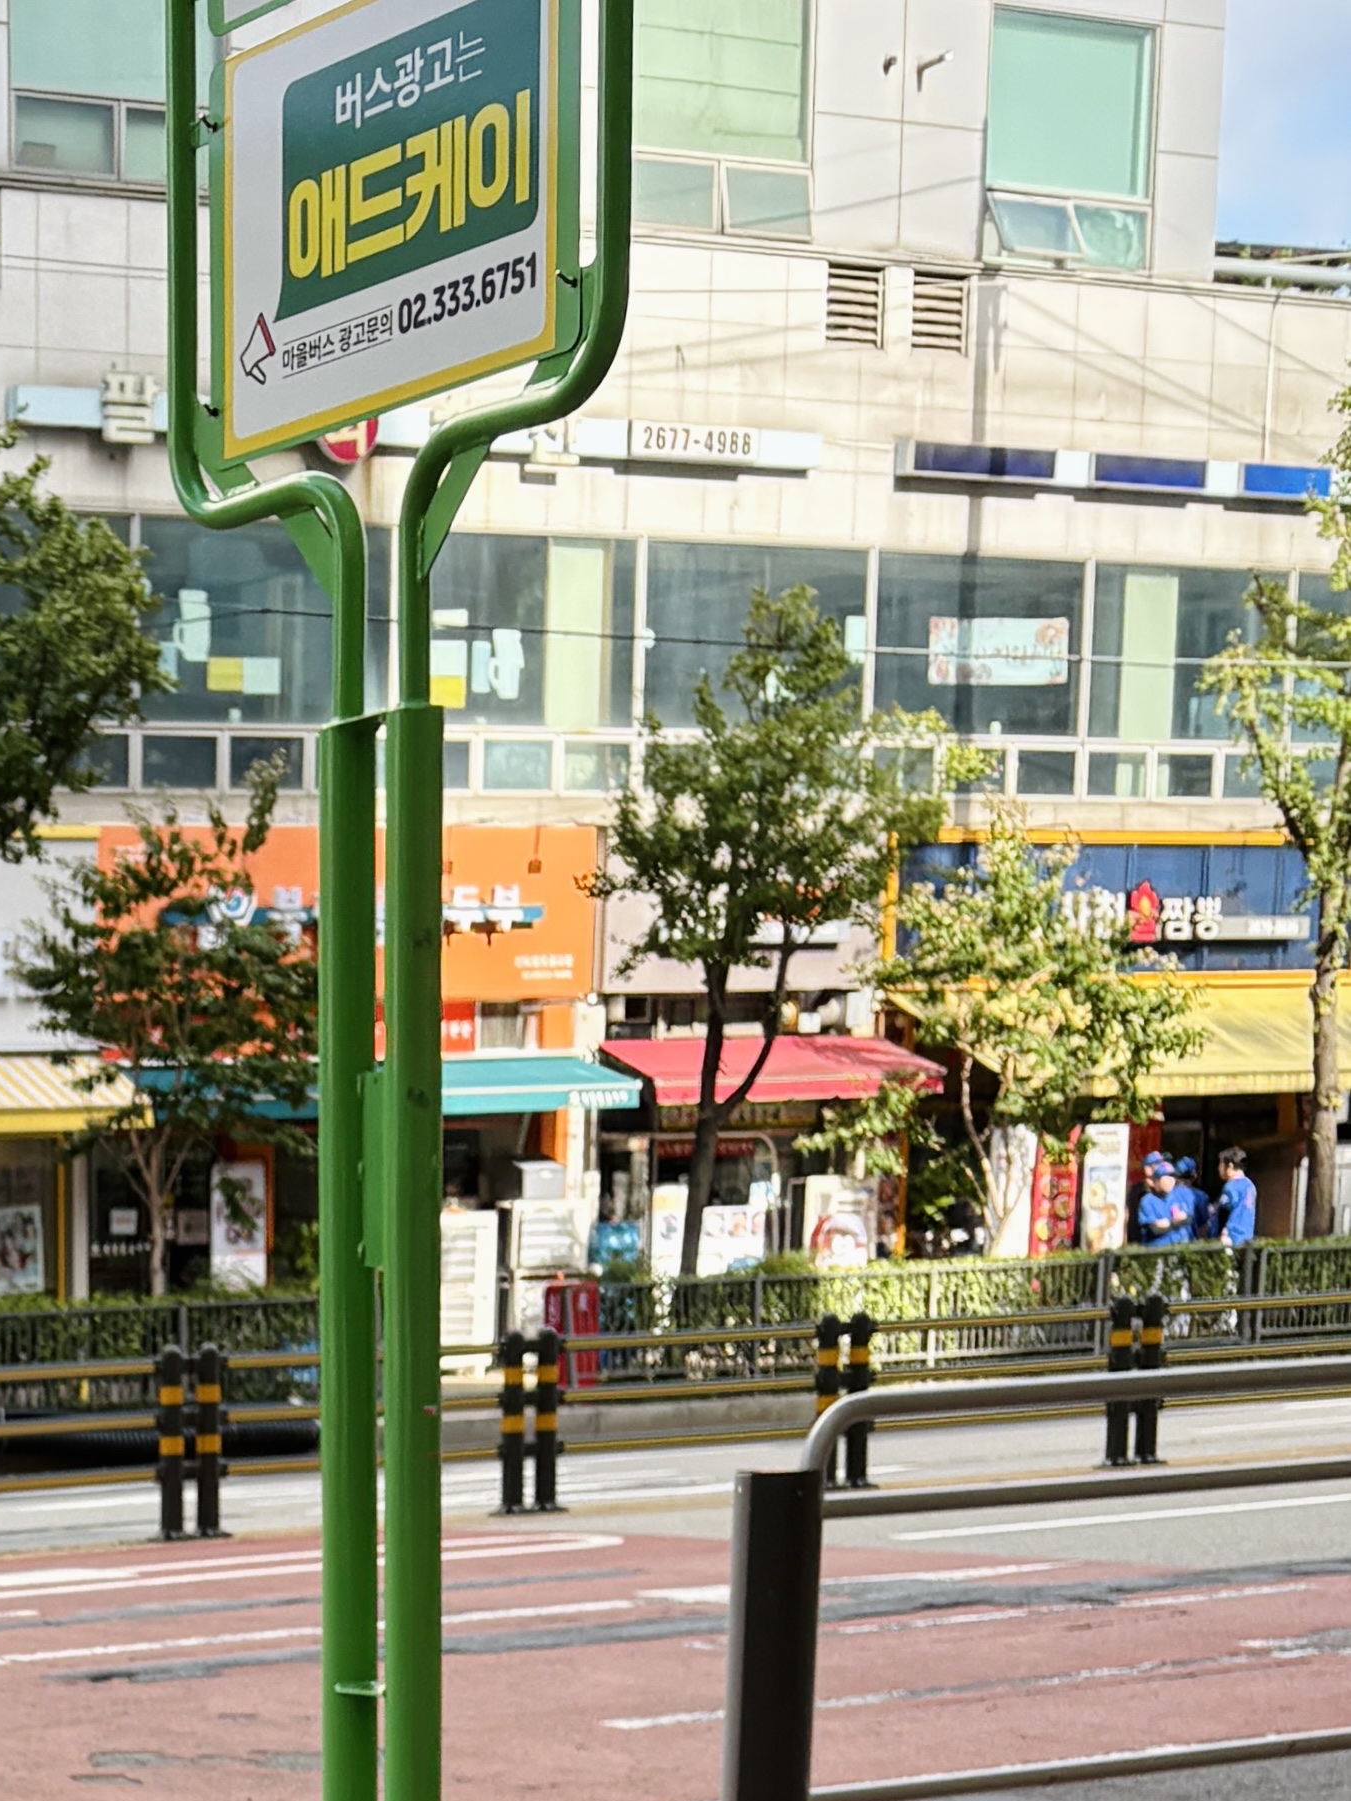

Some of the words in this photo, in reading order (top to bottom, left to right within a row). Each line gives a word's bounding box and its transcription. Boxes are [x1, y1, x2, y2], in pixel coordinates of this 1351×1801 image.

[335, 32, 486, 128] 버스광고는
[287, 89, 531, 279] 애드케이
[281, 337, 336, 371] 마을버스
[338, 309, 394, 352] 광고문의
[398, 253, 537, 334] 02.333.6751
[1159, 896, 1223, 940] 짬뽕
